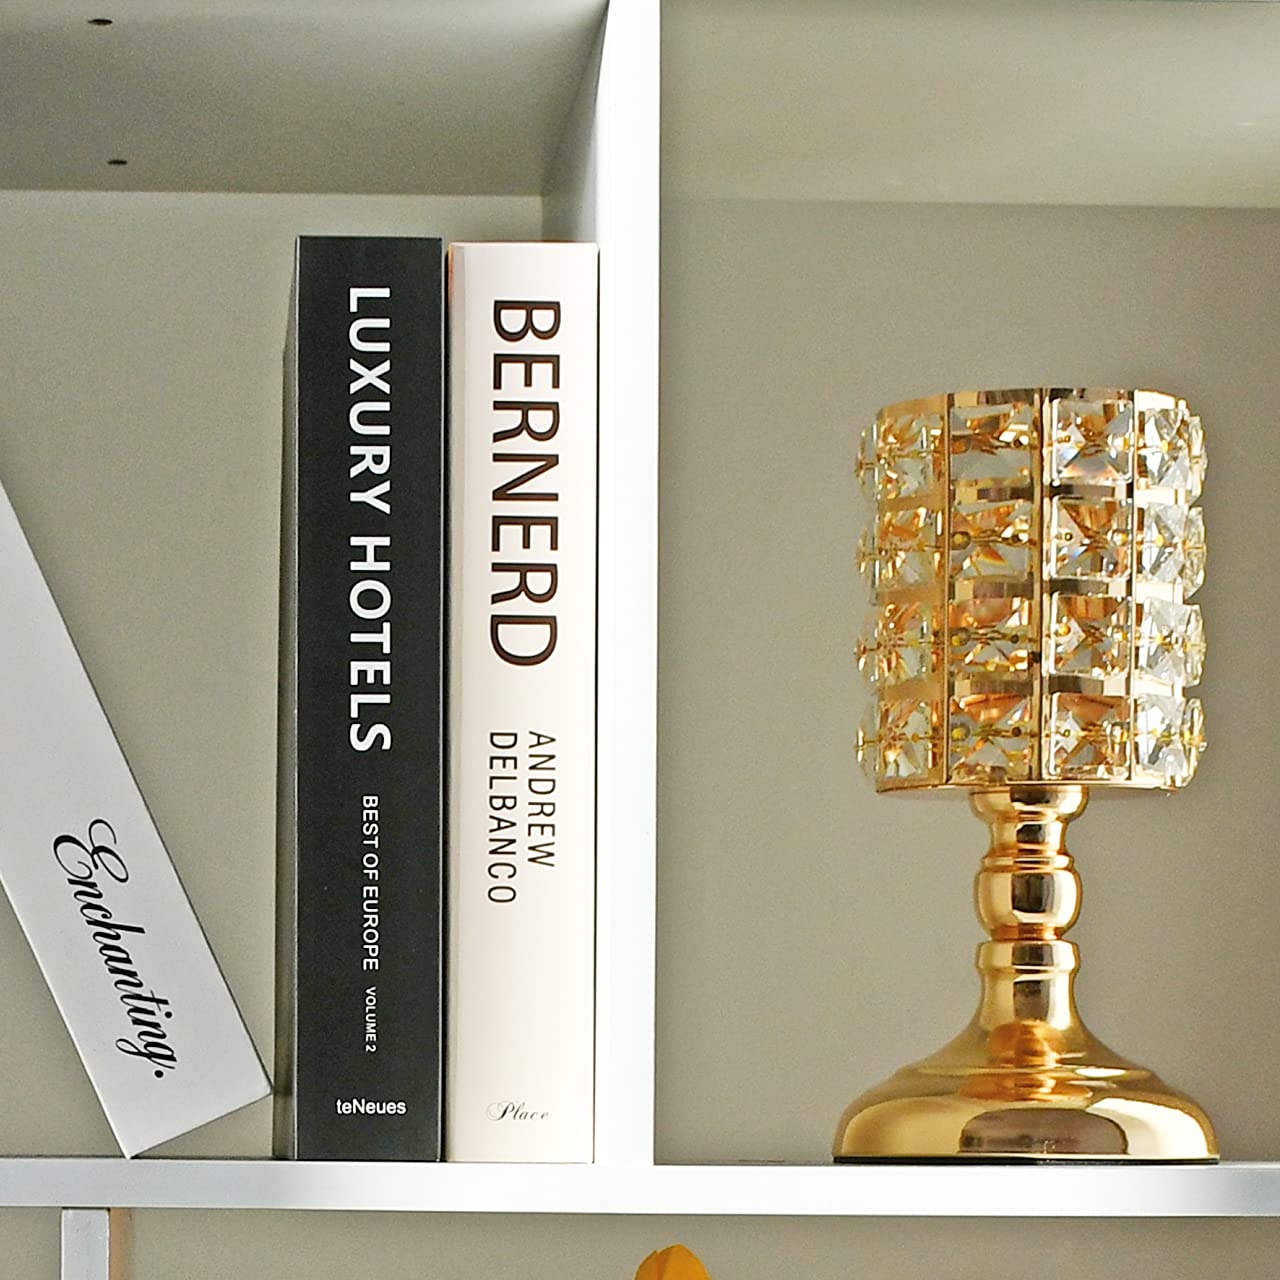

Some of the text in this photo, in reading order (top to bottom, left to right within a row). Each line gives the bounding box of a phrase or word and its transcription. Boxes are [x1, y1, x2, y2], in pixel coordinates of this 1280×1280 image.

[348, 287, 392, 752] LUXURY HOTELS
[490, 299, 562, 667] BERNERD
[487, 731, 519, 904] DELBANCO
[527, 730, 558, 868] ANDREW
[362, 795, 380, 971] BEST OF EUROPE
[365, 986, 377, 1053] VOLUME 2
[336, 1098, 407, 1115] teNeues
[486, 1102, 550, 1122] Place
